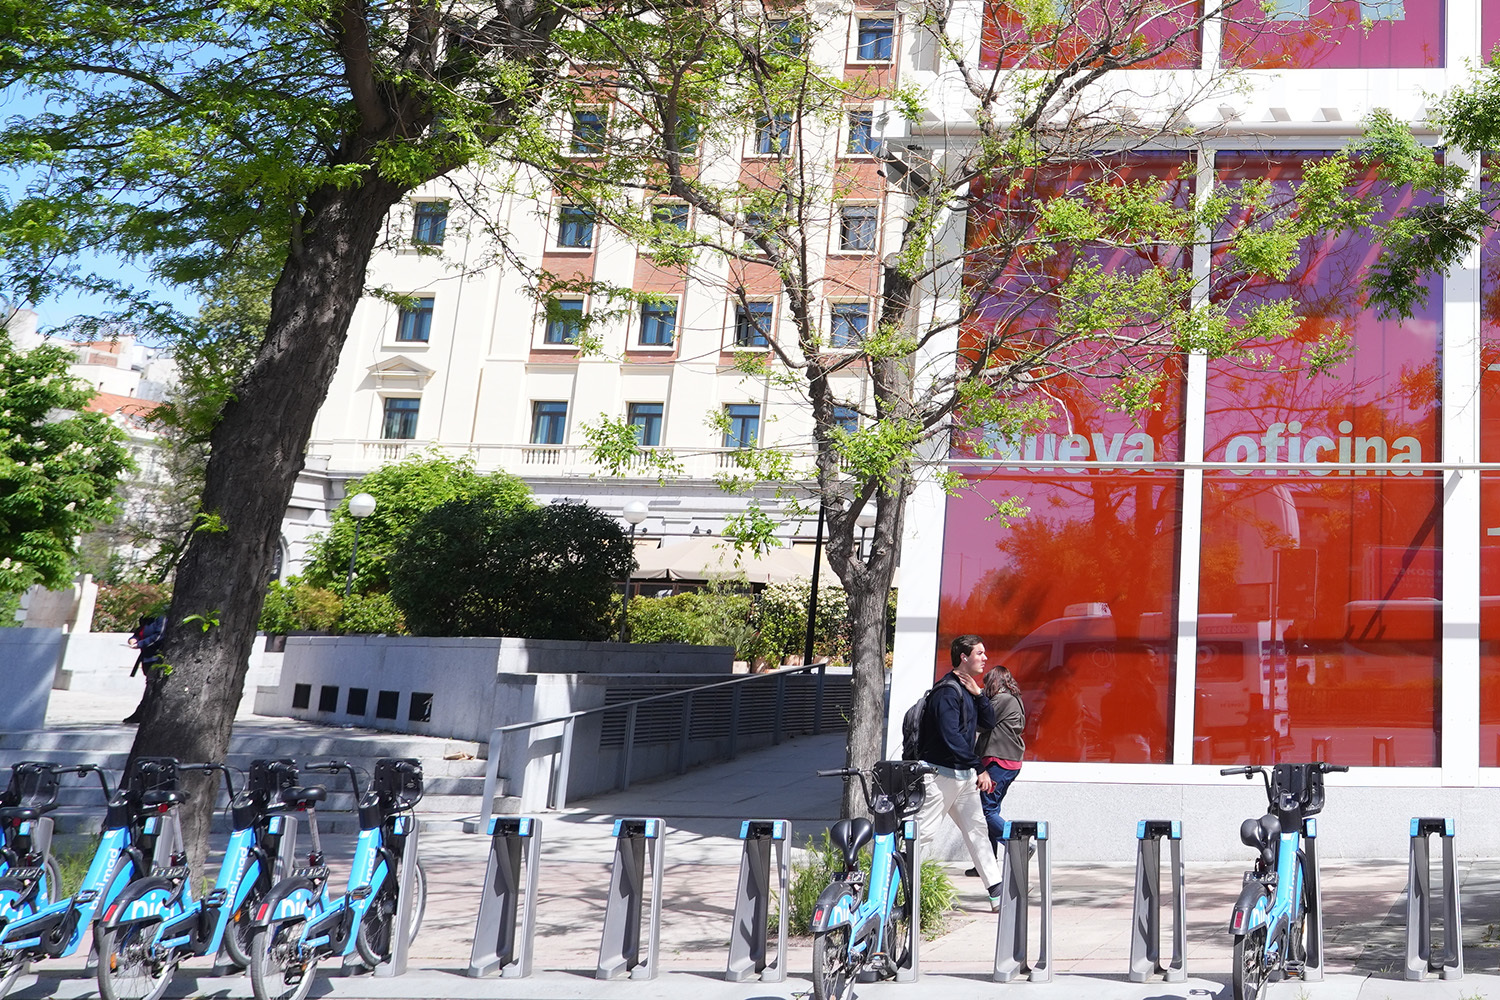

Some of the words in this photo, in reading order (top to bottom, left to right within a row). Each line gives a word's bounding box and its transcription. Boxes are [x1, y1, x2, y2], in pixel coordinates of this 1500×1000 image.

[980, 419, 1156, 474] Nueva
[1224, 420, 1424, 477] oficina
[358, 847, 376, 909] bimad
